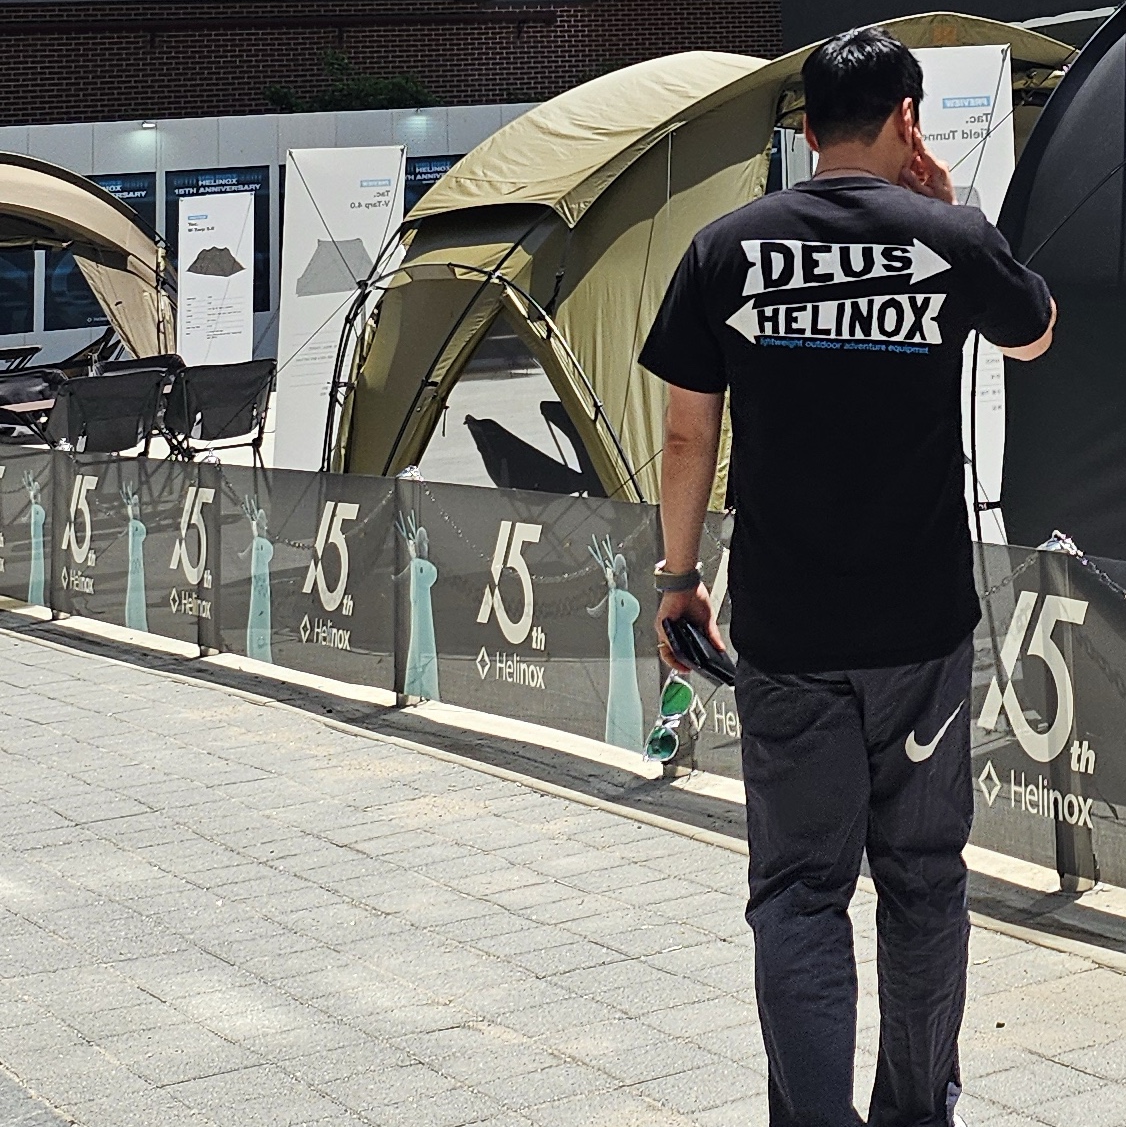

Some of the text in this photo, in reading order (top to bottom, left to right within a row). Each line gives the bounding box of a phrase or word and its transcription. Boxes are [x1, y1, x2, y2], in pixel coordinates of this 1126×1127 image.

[174, 183, 261, 195] 15TH ANNIVERSARY
[198, 178, 238, 187] HELINOX
[759, 242, 914, 291] DEUS
[756, 296, 931, 342] HELINOX
[805, 340, 841, 349] outdoor
[69, 569, 95, 595] Helinox
[181, 590, 212, 619] Helinox
[313, 618, 351, 650] Helinox
[495, 652, 546, 690] Helinox
[1010, 769, 1095, 829] Helinox
